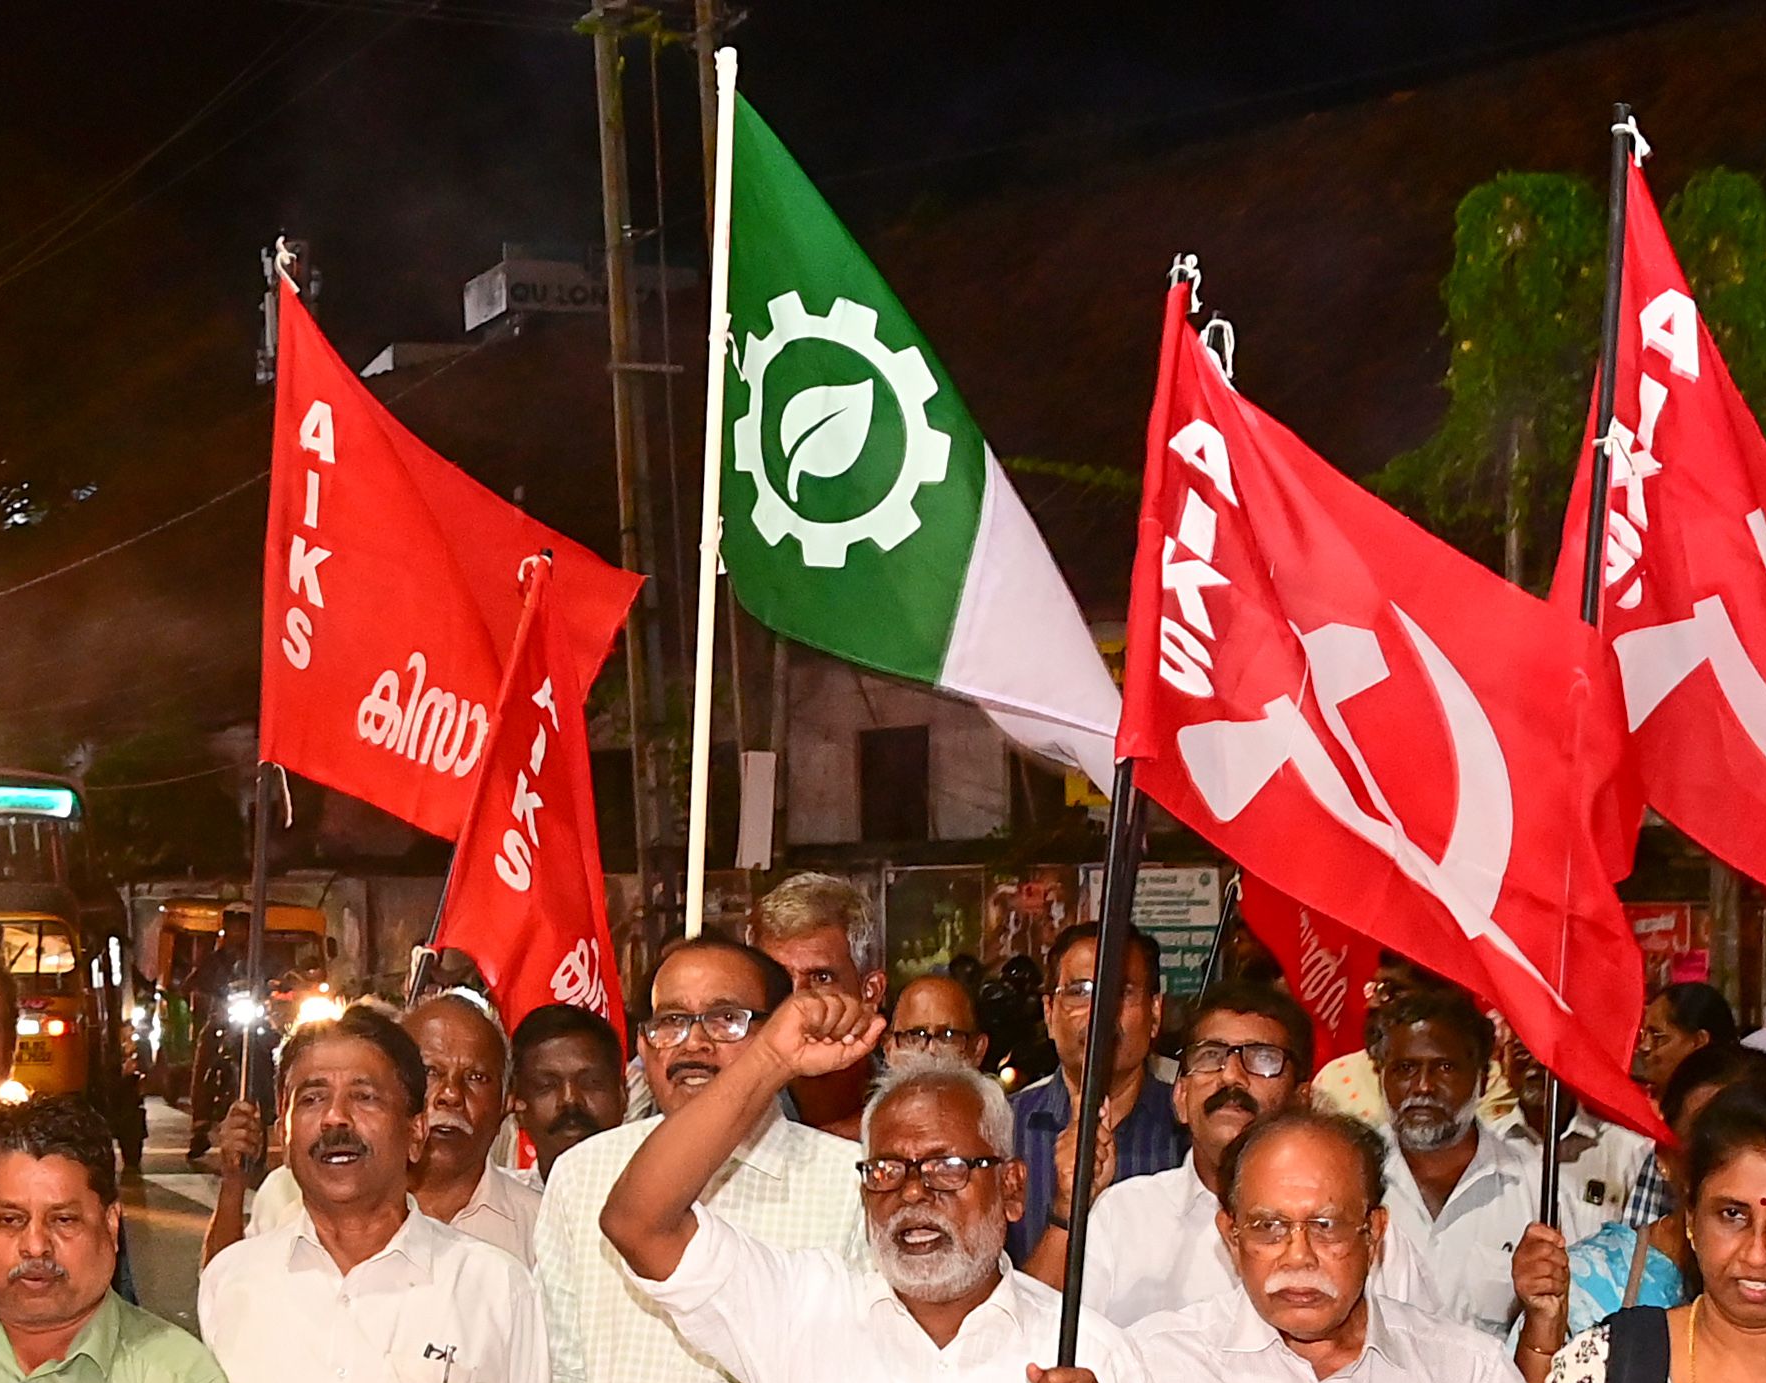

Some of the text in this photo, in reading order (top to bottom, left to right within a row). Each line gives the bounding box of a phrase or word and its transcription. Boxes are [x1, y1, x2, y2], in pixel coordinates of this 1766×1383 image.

[282, 399, 336, 671] AIKS
[1159, 418, 1241, 698] AIKS
[494, 675, 561, 892] AIKS
